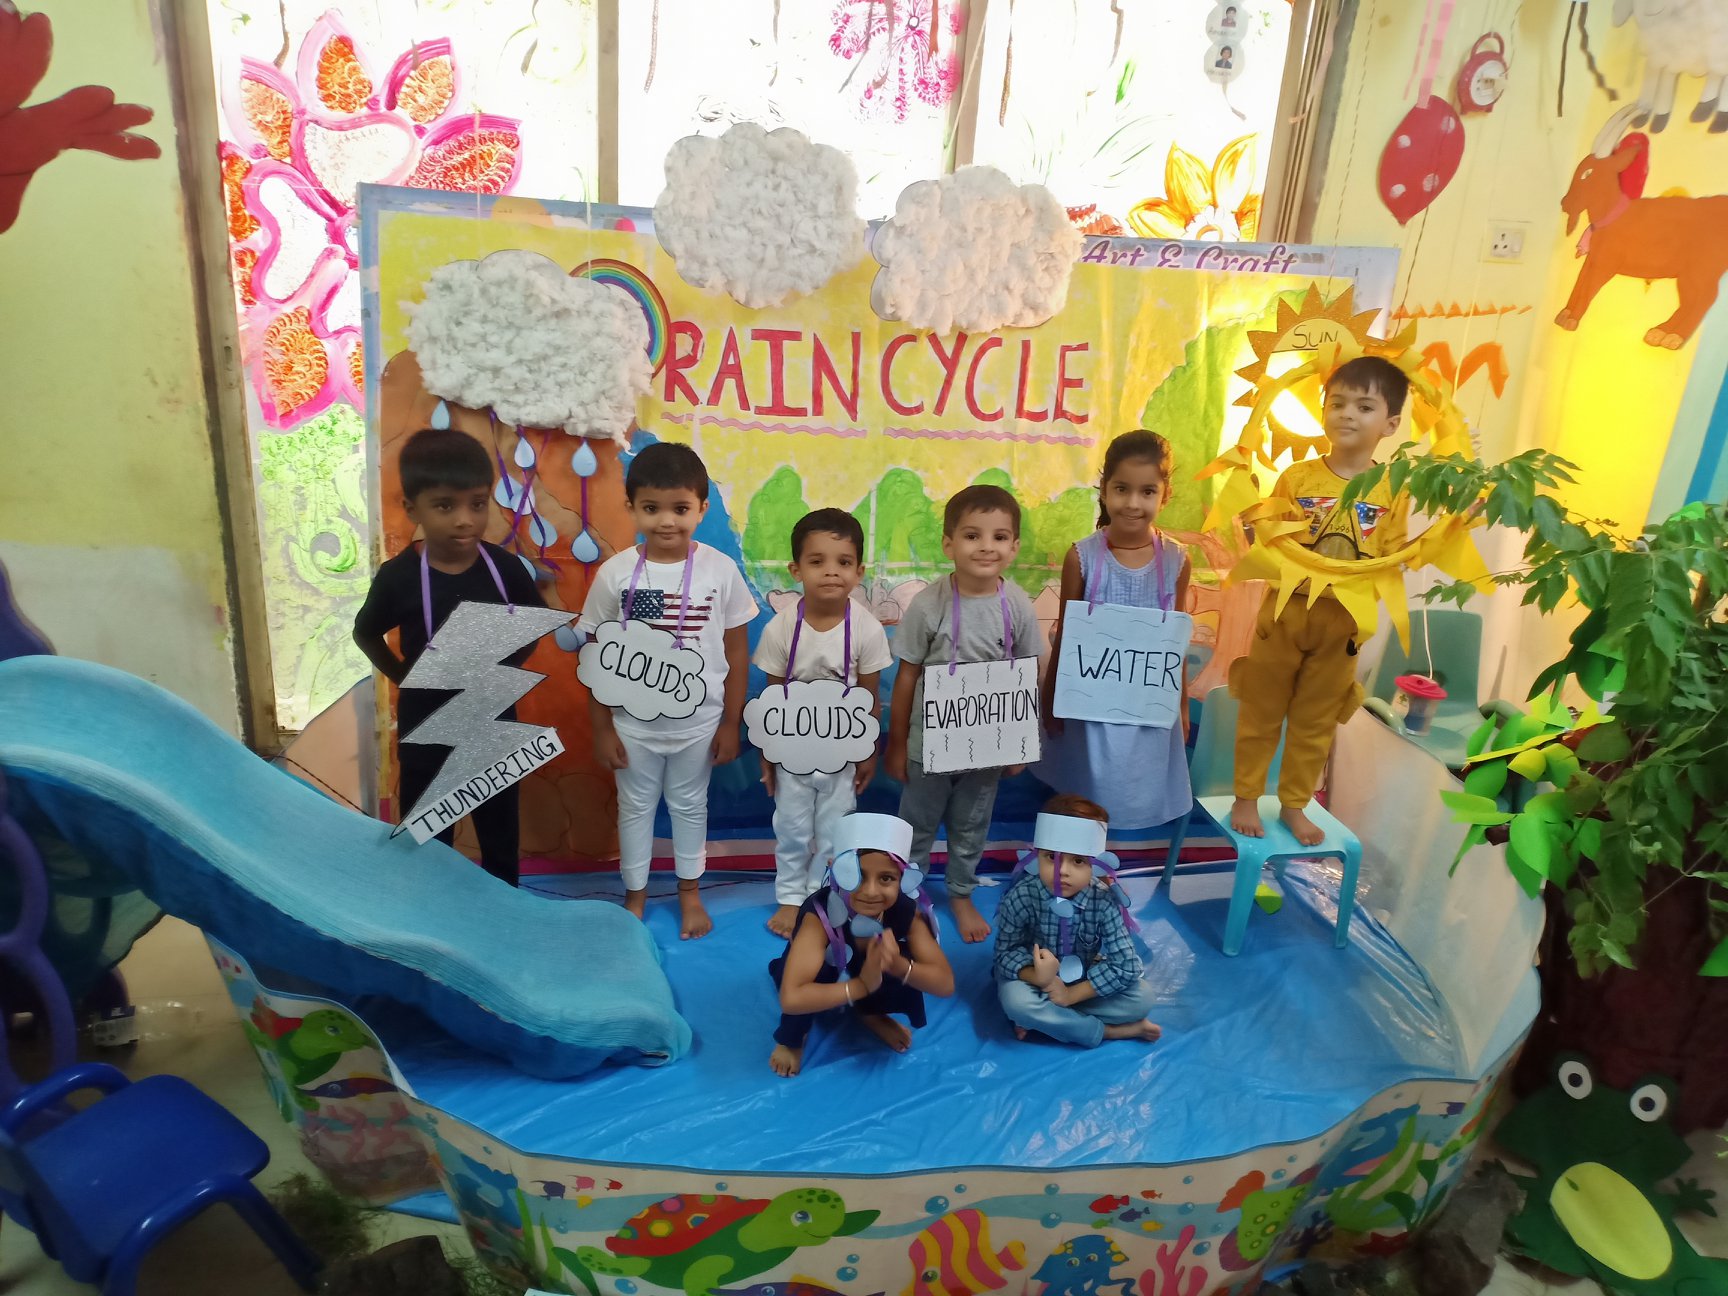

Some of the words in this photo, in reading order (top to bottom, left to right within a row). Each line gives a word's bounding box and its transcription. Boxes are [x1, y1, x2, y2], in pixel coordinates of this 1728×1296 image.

[1082, 239, 1144, 266] Art
[1196, 244, 1297, 273] Craft
[1292, 324, 1338, 348] SUN
[664, 320, 861, 422] RAIN
[880, 331, 1089, 424] CYCLE
[600, 641, 694, 702] CLOUDS
[1077, 644, 1181, 691] WATER
[763, 706, 866, 740] CLOUDS
[925, 687, 1039, 730] EVAPORATION
[411, 735, 557, 833] THUNDERING
